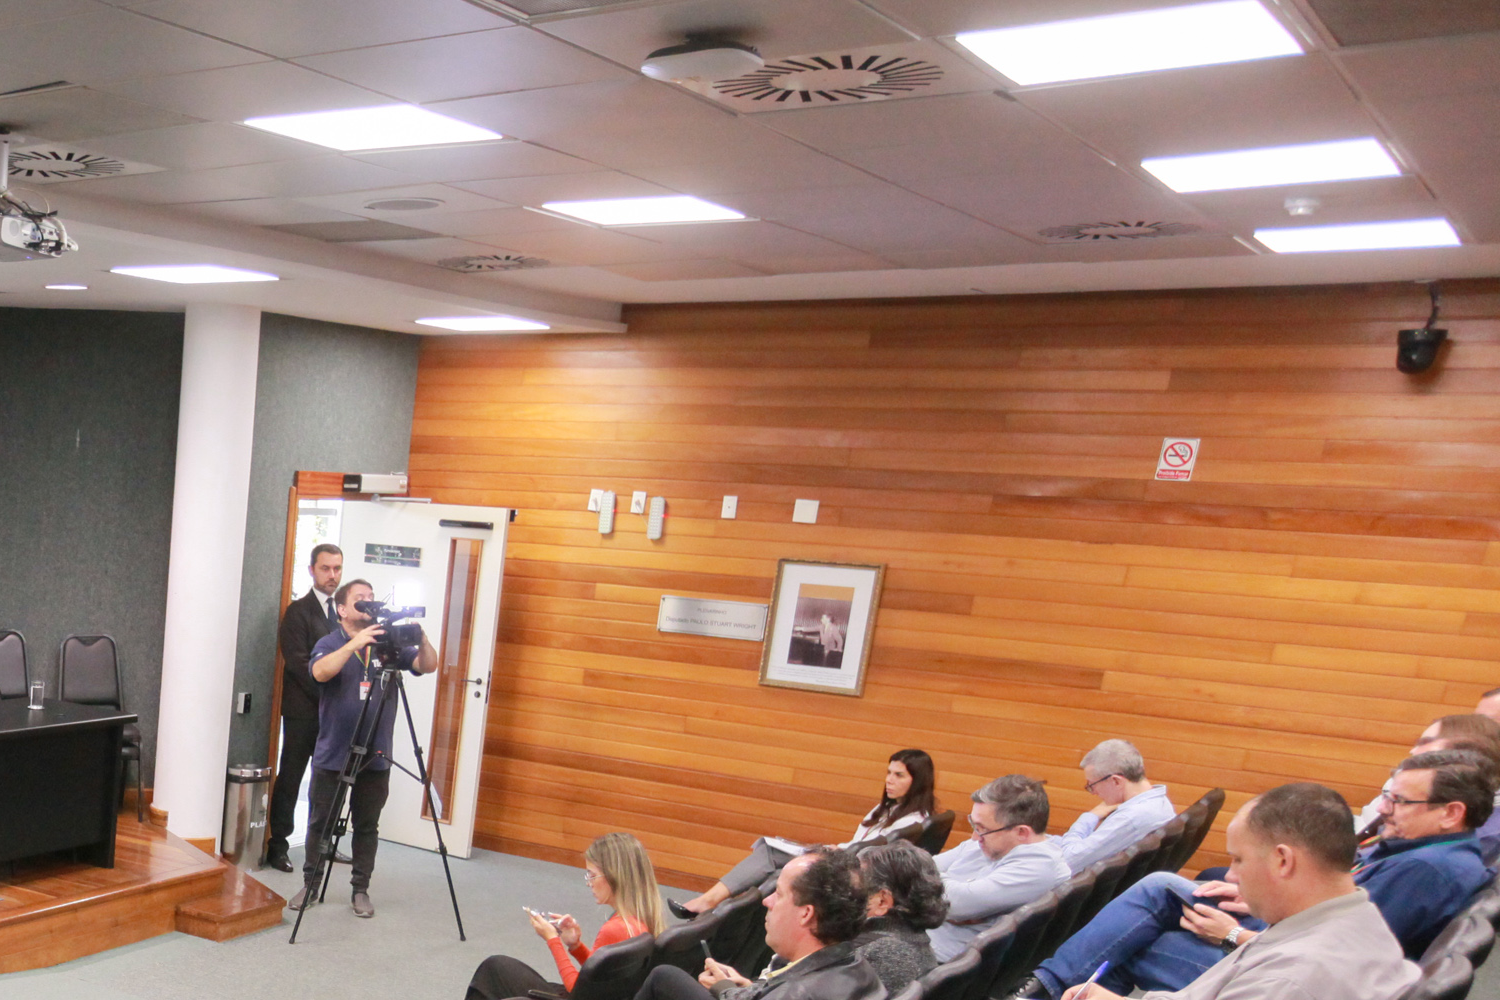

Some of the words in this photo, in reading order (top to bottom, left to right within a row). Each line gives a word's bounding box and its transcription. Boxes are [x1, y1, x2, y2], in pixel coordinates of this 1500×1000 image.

[665, 616, 689, 625] Deputado
[690, 618, 709, 626] PAULO
[710, 620, 732, 628] STUART
